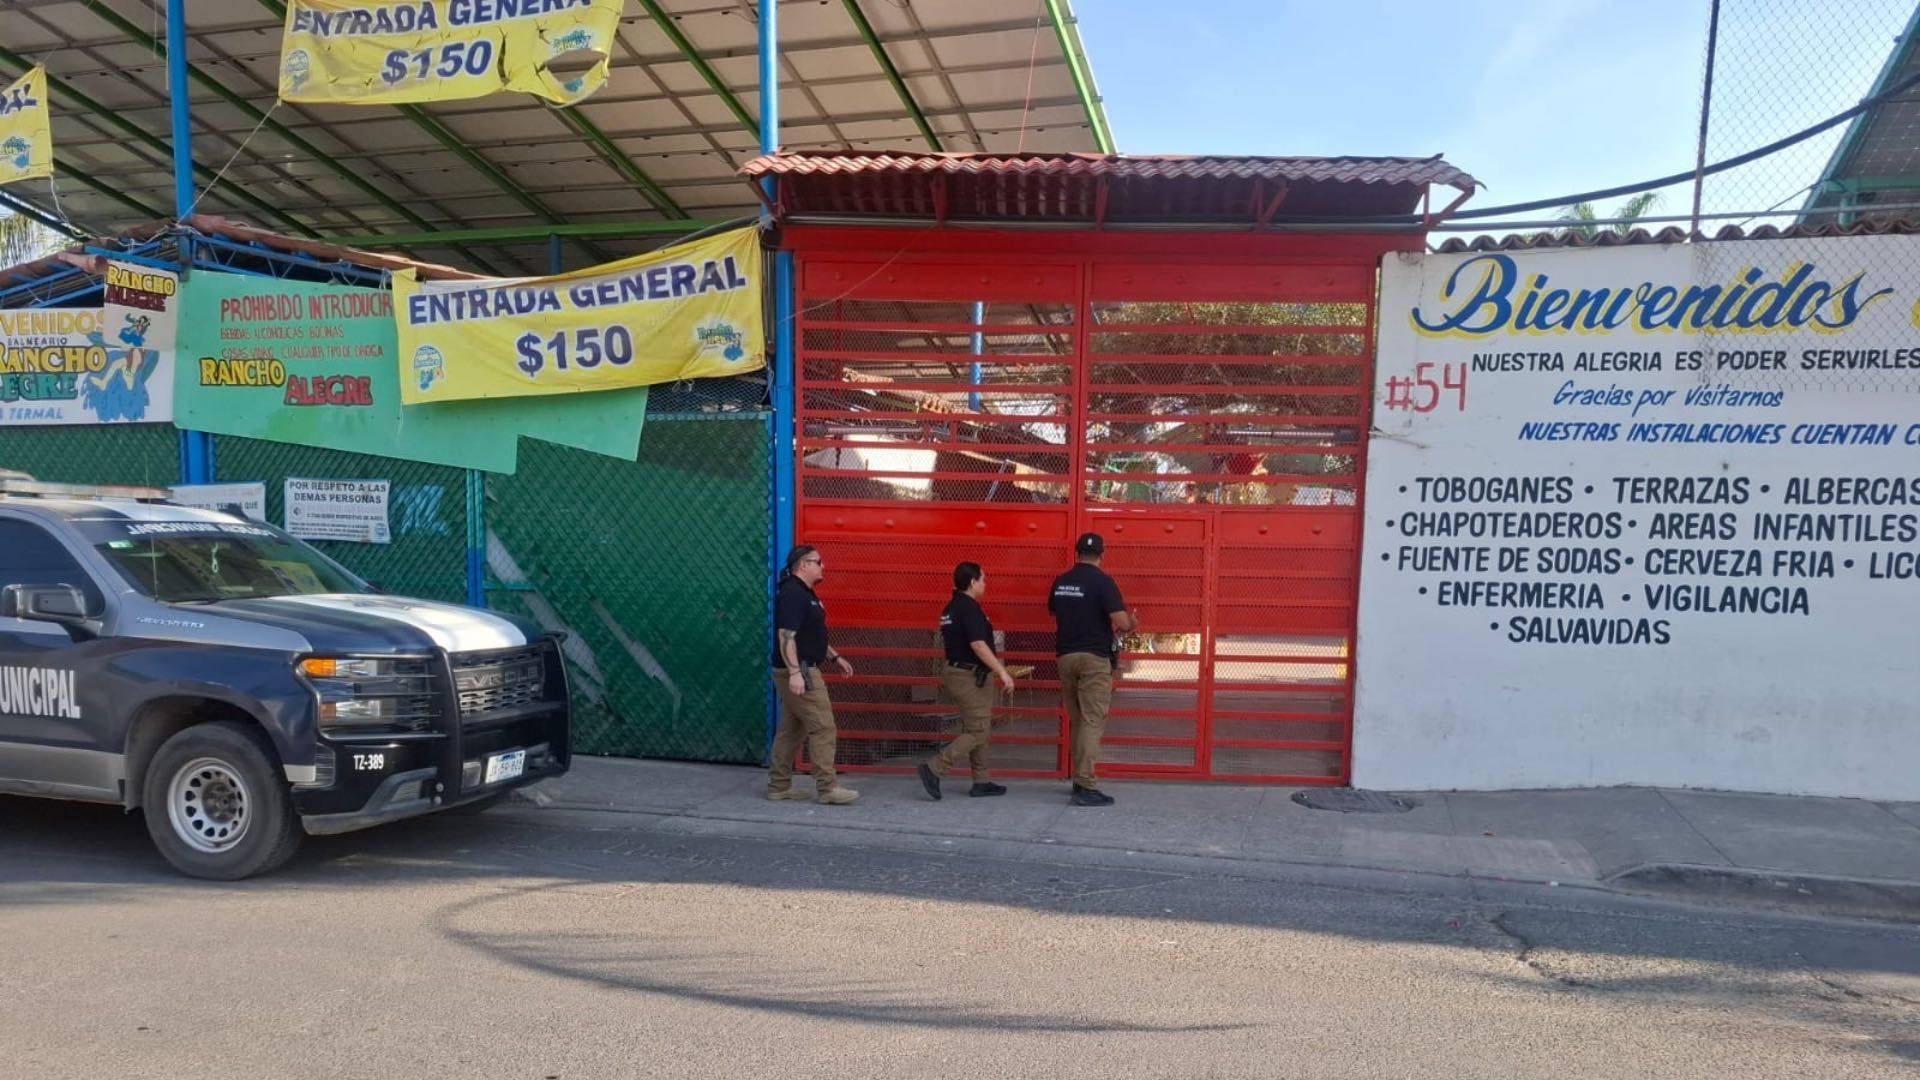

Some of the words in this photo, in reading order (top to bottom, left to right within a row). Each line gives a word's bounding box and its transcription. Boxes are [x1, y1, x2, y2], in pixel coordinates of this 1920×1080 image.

[292, 3, 438, 36] ENTRADA
[381, 41, 492, 84] $150
[106, 264, 175, 296] RANCHO
[408, 286, 561, 325] ENTRADA
[569, 256, 747, 308] GENERAL
[1410, 254, 1894, 338] Bienvenidos
[220, 294, 303, 322] PROHIBIDO
[308, 291, 393, 318] INTRODUCIR
[0, 311, 103, 336] VENIDO
[516, 324, 633, 378] $150
[1472, 353, 1564, 373] NUESTRA
[1574, 352, 1662, 372] ALEGRIA
[1675, 351, 1702, 371] ES
[1717, 350, 1787, 370] PODER
[1800, 348, 1920, 370] SERVIRLES
[0, 373, 78, 402] EGRE
[199, 357, 286, 388] RANCHO
[1385, 361, 1467, 413] #54
[283, 374, 373, 406] ALEGRE
[1553, 379, 1634, 406] Gracias
[1632, 388, 1676, 417] por
[10, 408, 63, 420] TERMAL
[1518, 422, 1621, 441] NUESTRAS
[1626, 423, 1786, 444] INSTALACIONES
[1790, 424, 1897, 445] CUENTAN
[1904, 424, 1920, 445] C
[290, 481, 309, 491] POR
[311, 481, 355, 492] RESPETO
[358, 483, 365, 492] A
[368, 484, 386, 493] LAS
[329, 493, 382, 504] PERSONAS
[1416, 476, 1574, 504] TOBOGANES
[1612, 476, 1750, 505] TERRAZAS
[1784, 477, 1920, 506] ALBERCAS
[1399, 511, 1622, 540] CHAPOTEADEROS
[1648, 513, 1737, 541] AREAS
[1753, 513, 1918, 543] INFANTILES
[1398, 545, 1490, 572] FUENTE
[1497, 547, 1529, 572] DE
[1536, 547, 1621, 575] SODAS
[1644, 548, 1763, 577] CERVEZA
[1772, 550, 1834, 578] FRIA
[1868, 551, 1920, 580] LIC
[1437, 581, 1604, 610] ENFERMERIA
[1644, 583, 1809, 616] VIGILANCIA
[1507, 616, 1671, 645] SALVAVIDAS
[0, 666, 81, 719] UNICIPAL
[353, 754, 385, 770] TZ-389
